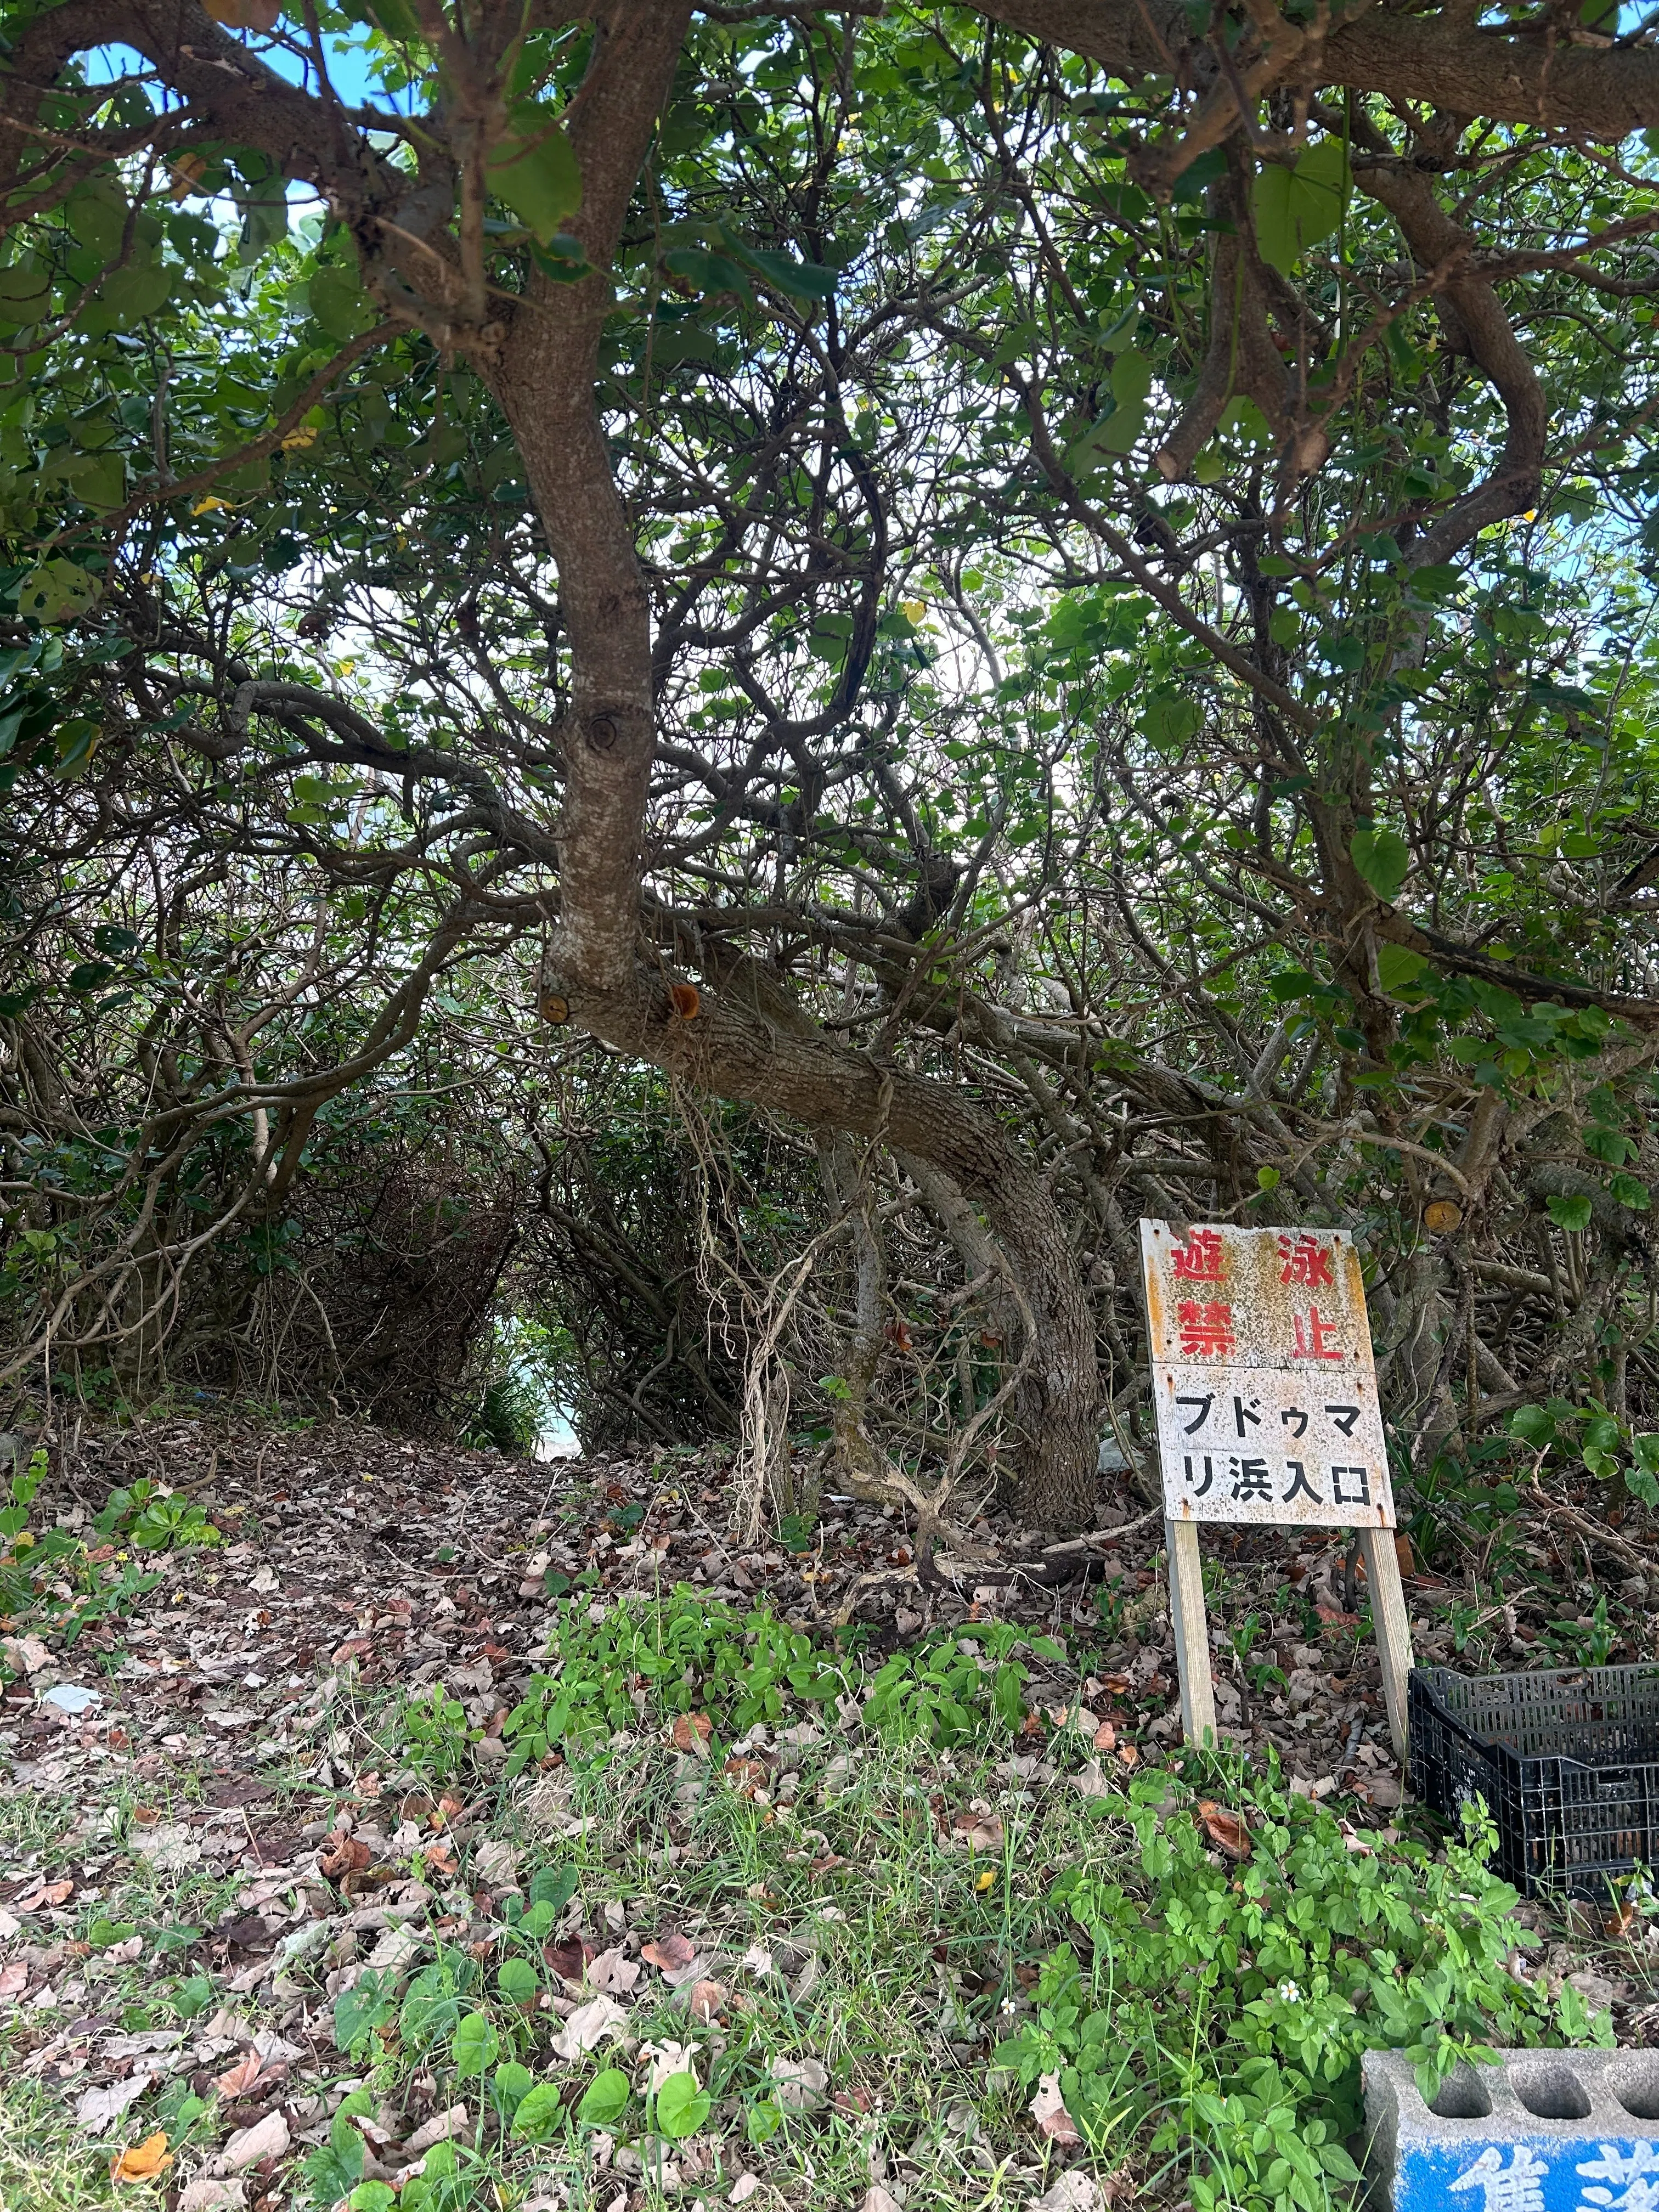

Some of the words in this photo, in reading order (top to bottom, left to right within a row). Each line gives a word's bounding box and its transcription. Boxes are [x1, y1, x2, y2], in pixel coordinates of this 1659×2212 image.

[1169, 1229, 1334, 1287] 遊泳
[1177, 1300, 1344, 1360] 禁止
[1176, 1392, 1361, 1438] ブドゥマ
[1184, 1455, 1371, 1506] リ浜入口
